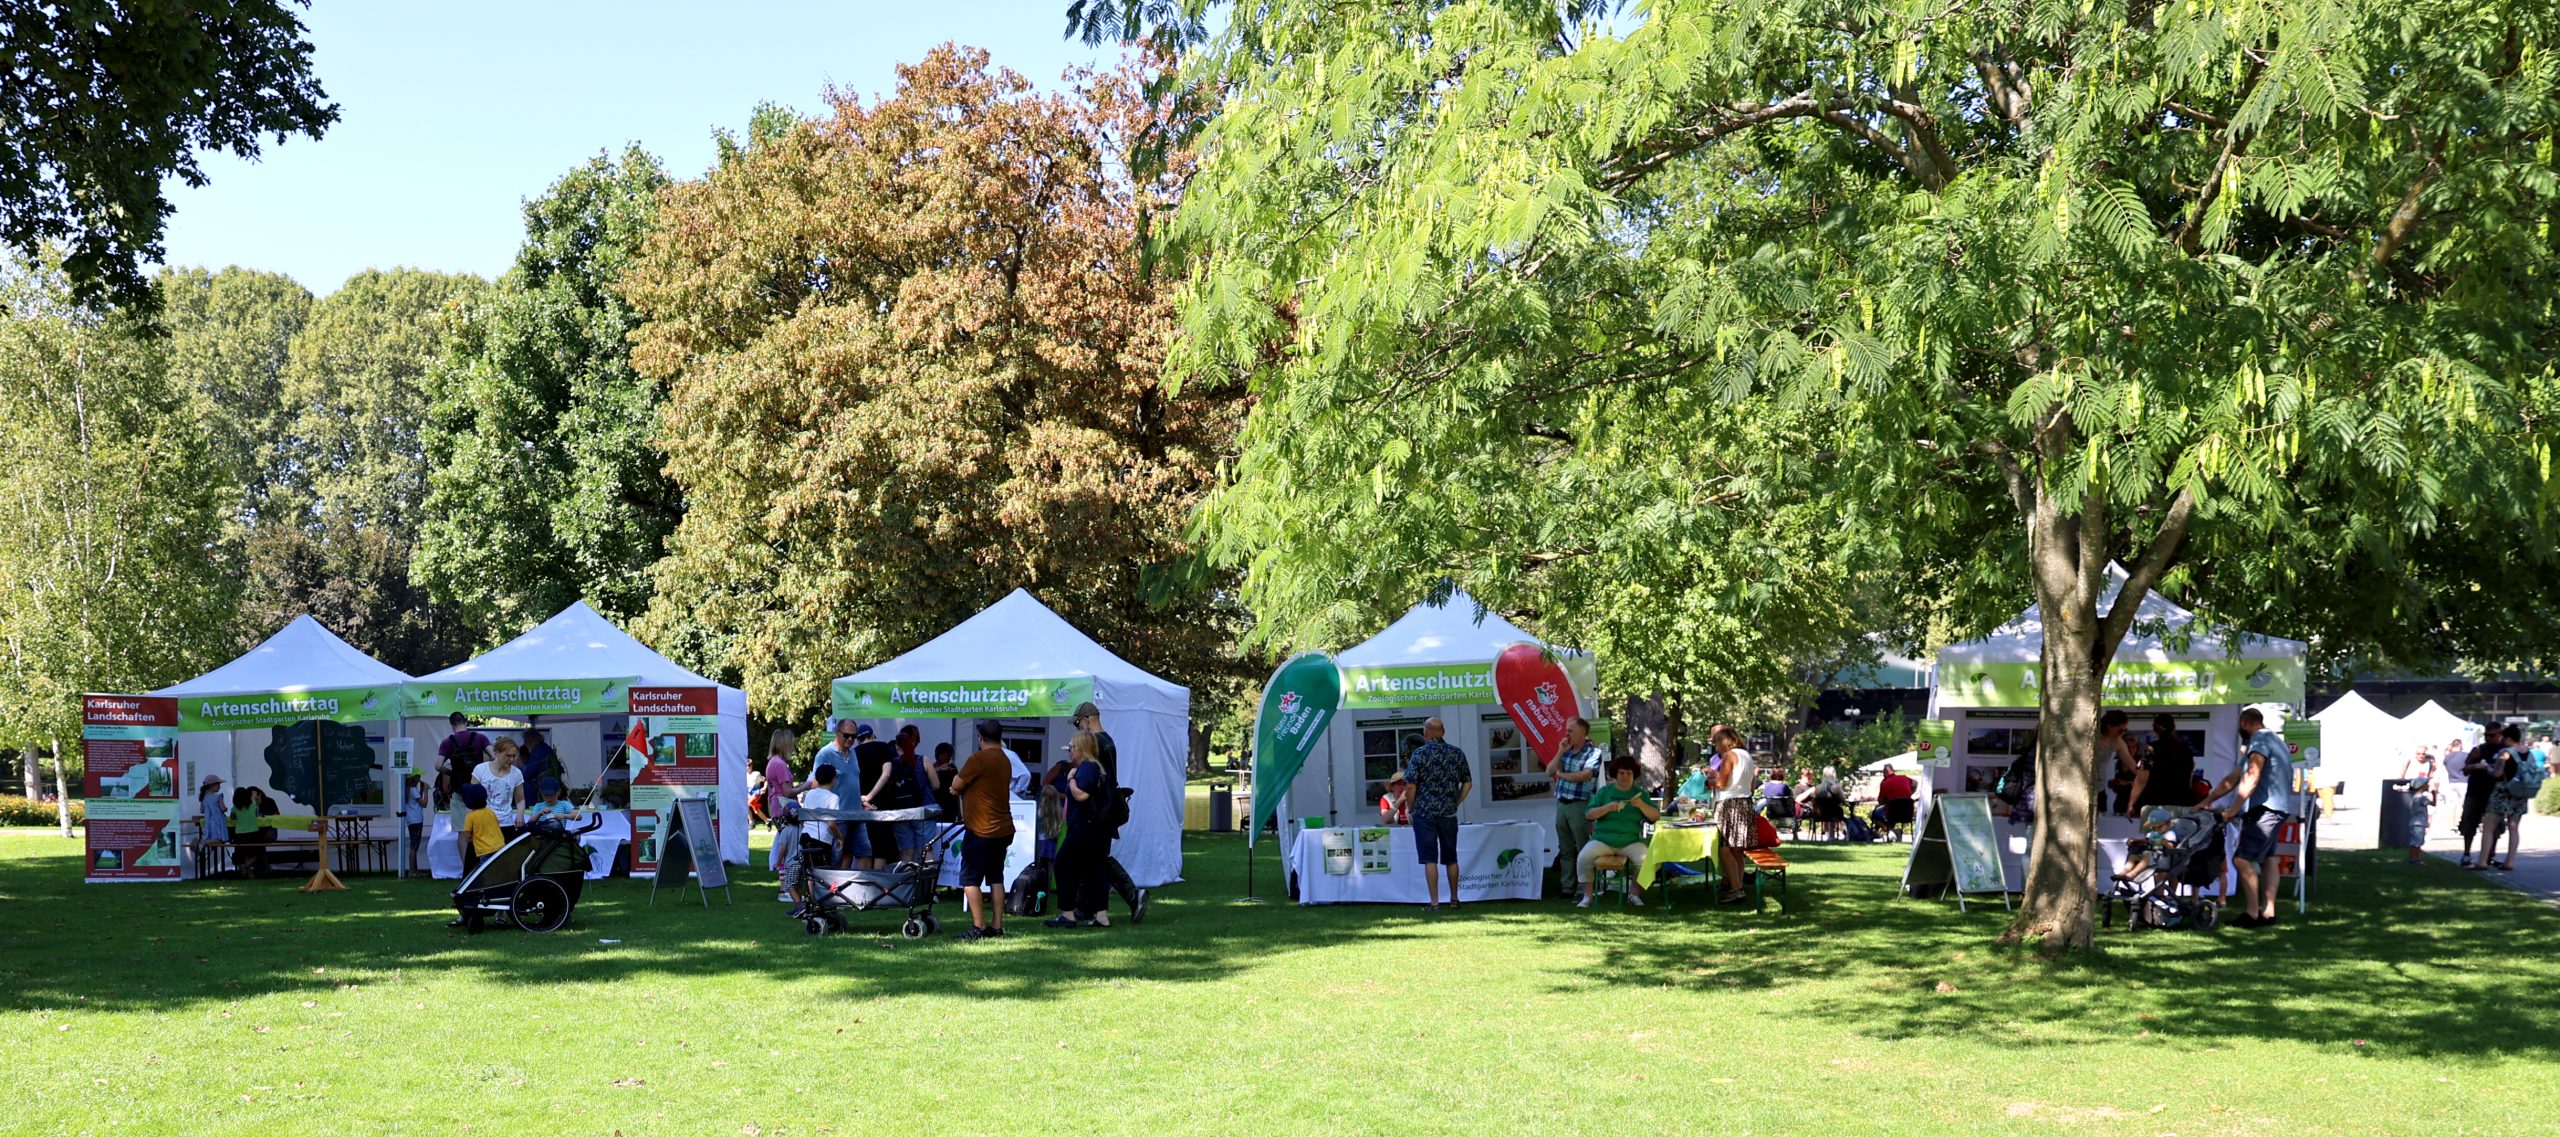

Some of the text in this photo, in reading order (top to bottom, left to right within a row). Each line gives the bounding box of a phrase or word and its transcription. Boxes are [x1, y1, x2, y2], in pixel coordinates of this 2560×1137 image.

[1356, 670, 1493, 692] Artenschutzt
[454, 685, 581, 704] Artenschutztag
[632, 691, 682, 700] Karlsruher
[890, 685, 1029, 706] Artenschutztag
[1367, 690, 1495, 704] Zoologischer Stadtgarten Karlsr
[87, 699, 141, 709] Karlsruher
[201, 696, 339, 717] Artenschutztag
[463, 702, 572, 712] Zoologischer Stadtgarten Karlsruhe
[632, 703, 697, 713] Landschaften
[900, 704, 1019, 715] Zoologischer Stadtgarten Karlsruhe
[87, 711, 155, 722] Landschaften
[212, 717, 254, 727] Zoologischer
[255, 715, 296, 725] Stadtgarten
[1289, 706, 1312, 735] Baden
[1276, 712, 1298, 741] Freunde
